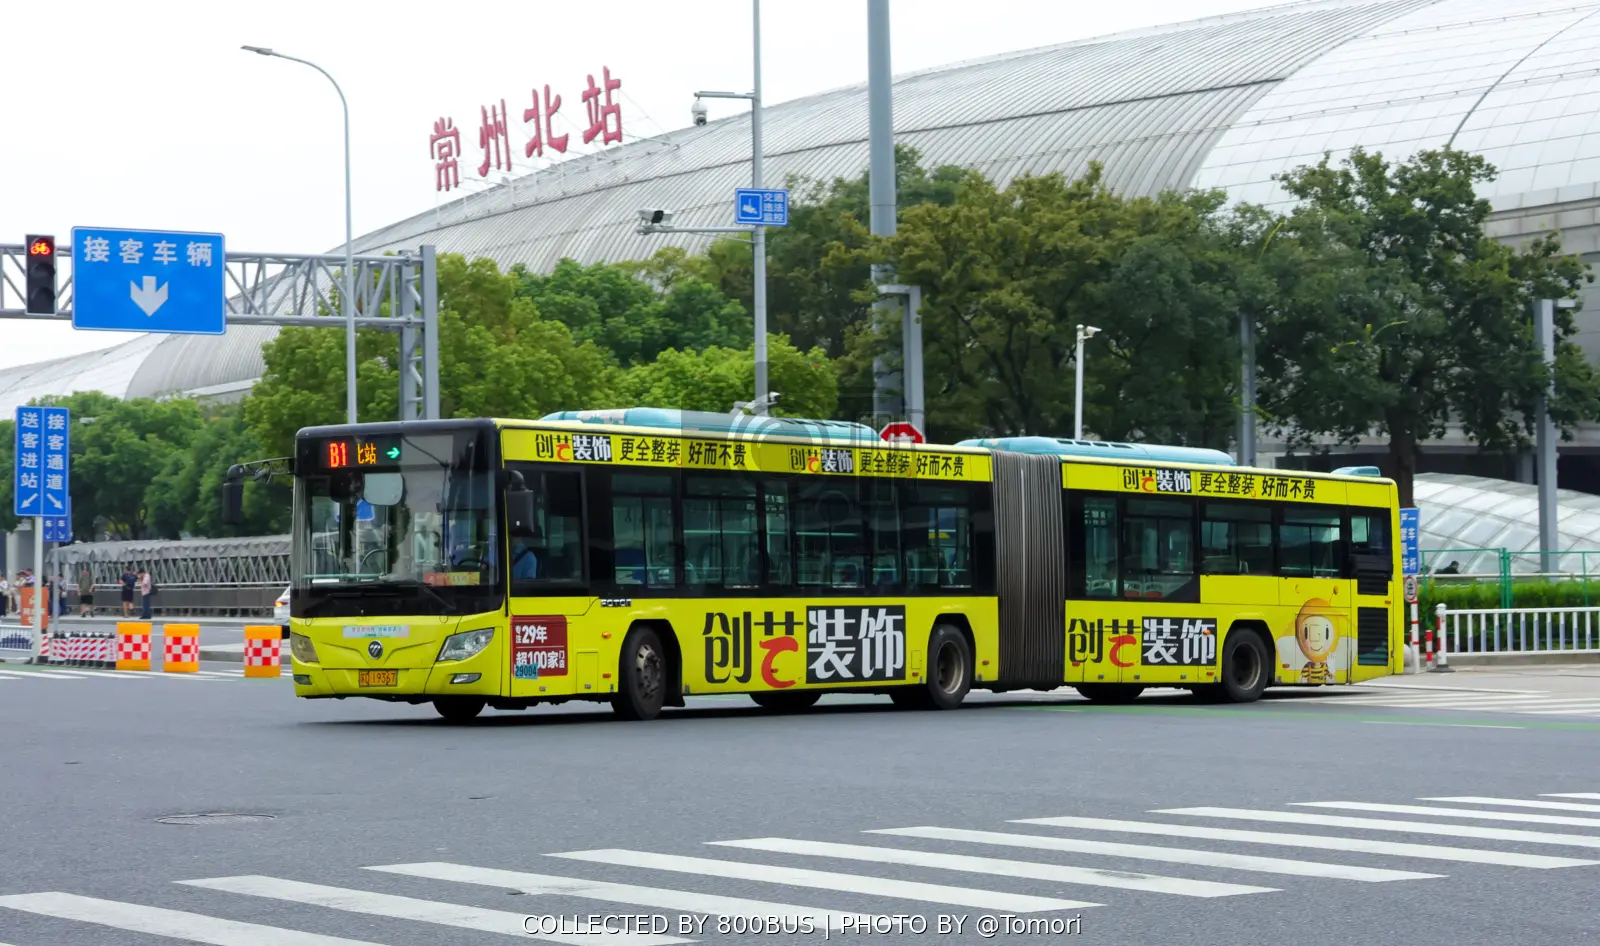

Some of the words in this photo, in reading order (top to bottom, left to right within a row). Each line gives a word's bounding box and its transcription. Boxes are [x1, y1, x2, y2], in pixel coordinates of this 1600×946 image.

[430, 65, 622, 191] 常州北站
[83, 235, 213, 268] 接客车辆
[20, 412, 39, 489] 送客进站
[46, 413, 65, 490] 接客通道
[329, 442, 347, 468] B1
[535, 433, 612, 463] 创艺装饰
[619, 437, 682, 465] 更全整装
[688, 441, 747, 466] 好而不贵
[789, 448, 853, 473] 创艺装饰
[860, 450, 912, 476] 更全整装
[916, 454, 964, 477] 好而不贵
[1122, 468, 1192, 493] 创艺装饰
[1199, 472, 1256, 497] 更全整装
[1261, 475, 1316, 499] 好而不贵
[702, 607, 905, 689] 创艺装饰
[1068, 617, 1217, 668] 创艺装饰
[515, 665, 537, 677] 29004
